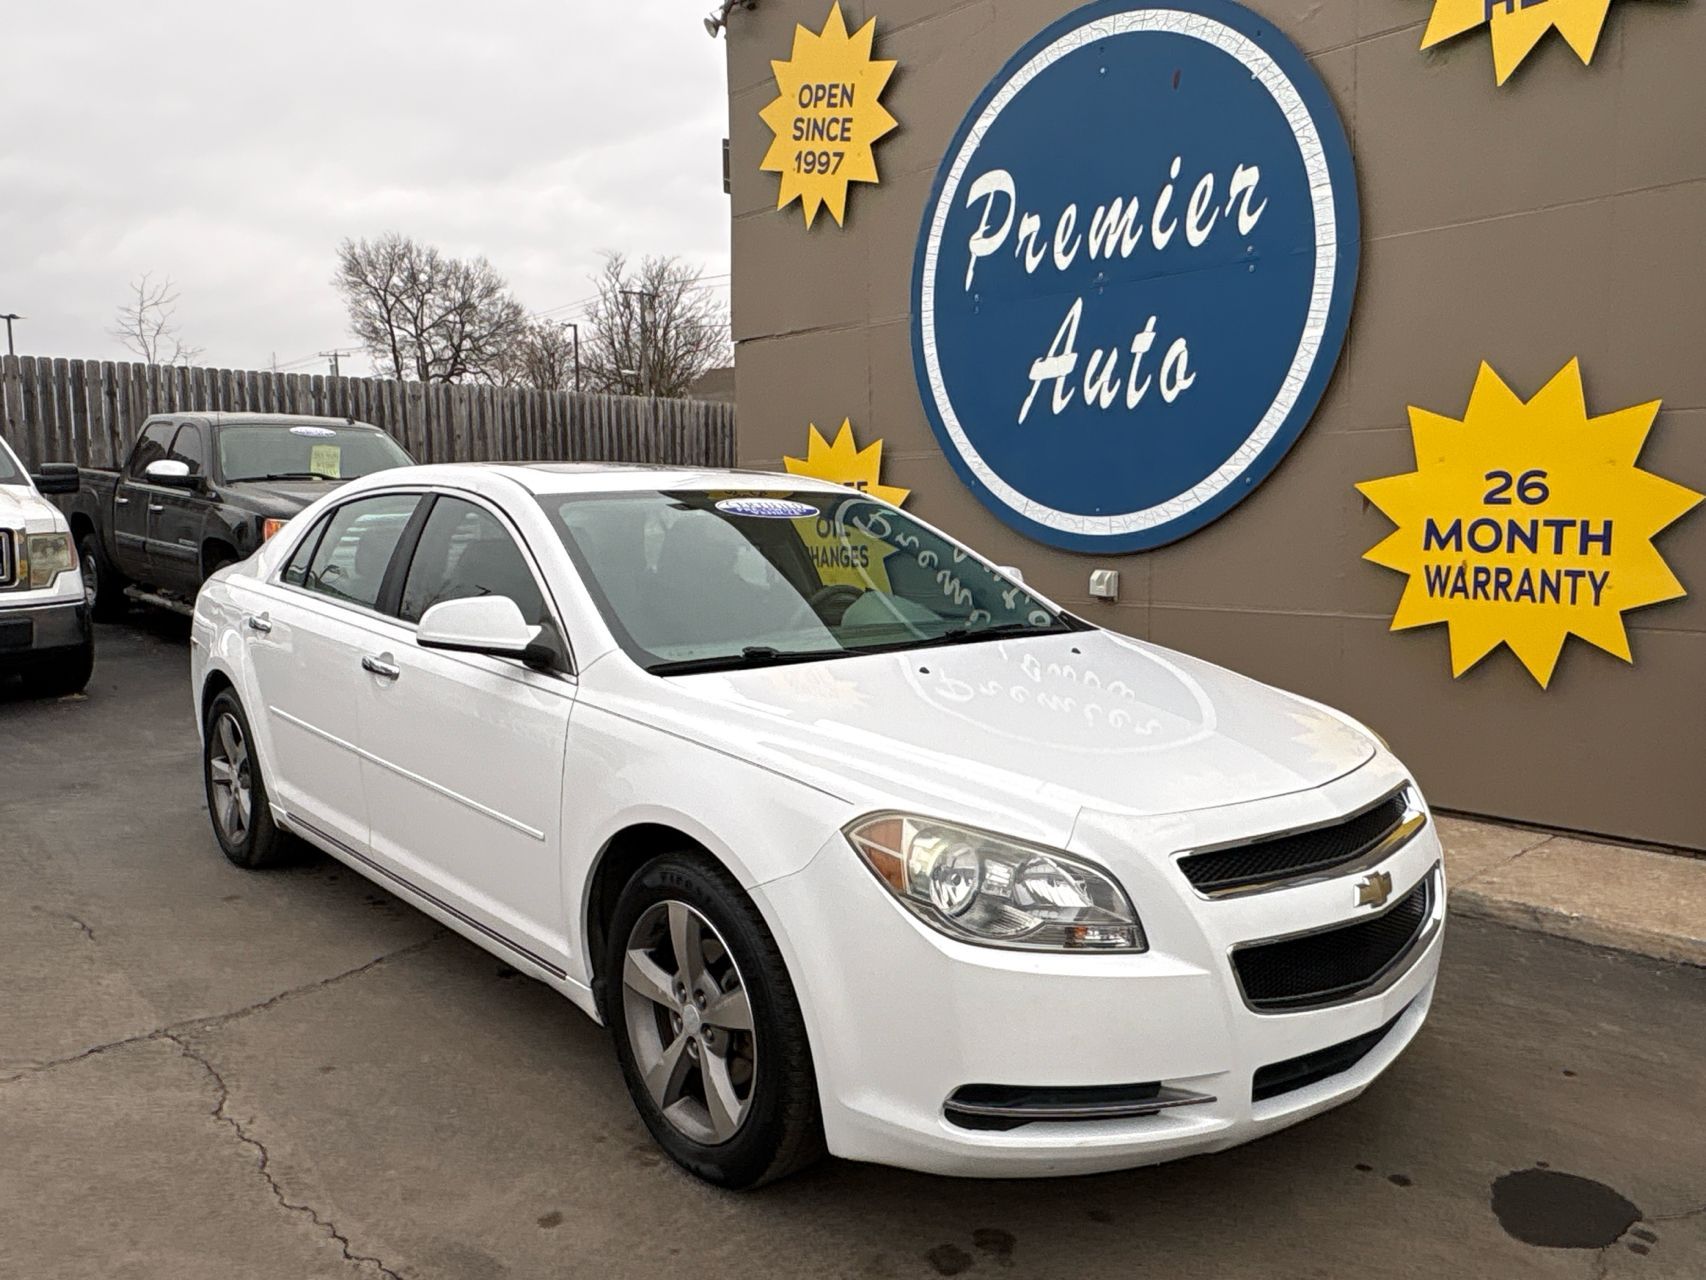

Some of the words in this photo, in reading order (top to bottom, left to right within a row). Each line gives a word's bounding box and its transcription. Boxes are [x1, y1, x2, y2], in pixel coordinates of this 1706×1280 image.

[798, 83, 855, 109] OPEN
[792, 117, 853, 142] SINCE
[794, 151, 844, 175] 1997
[965, 156, 1268, 292] Premier
[1018, 297, 1196, 425] Auto
[1483, 470, 1550, 505] 26
[1423, 518, 1613, 556] MONTH
[809, 545, 869, 568] HANGES
[1424, 564, 1610, 607] WARRANTY
